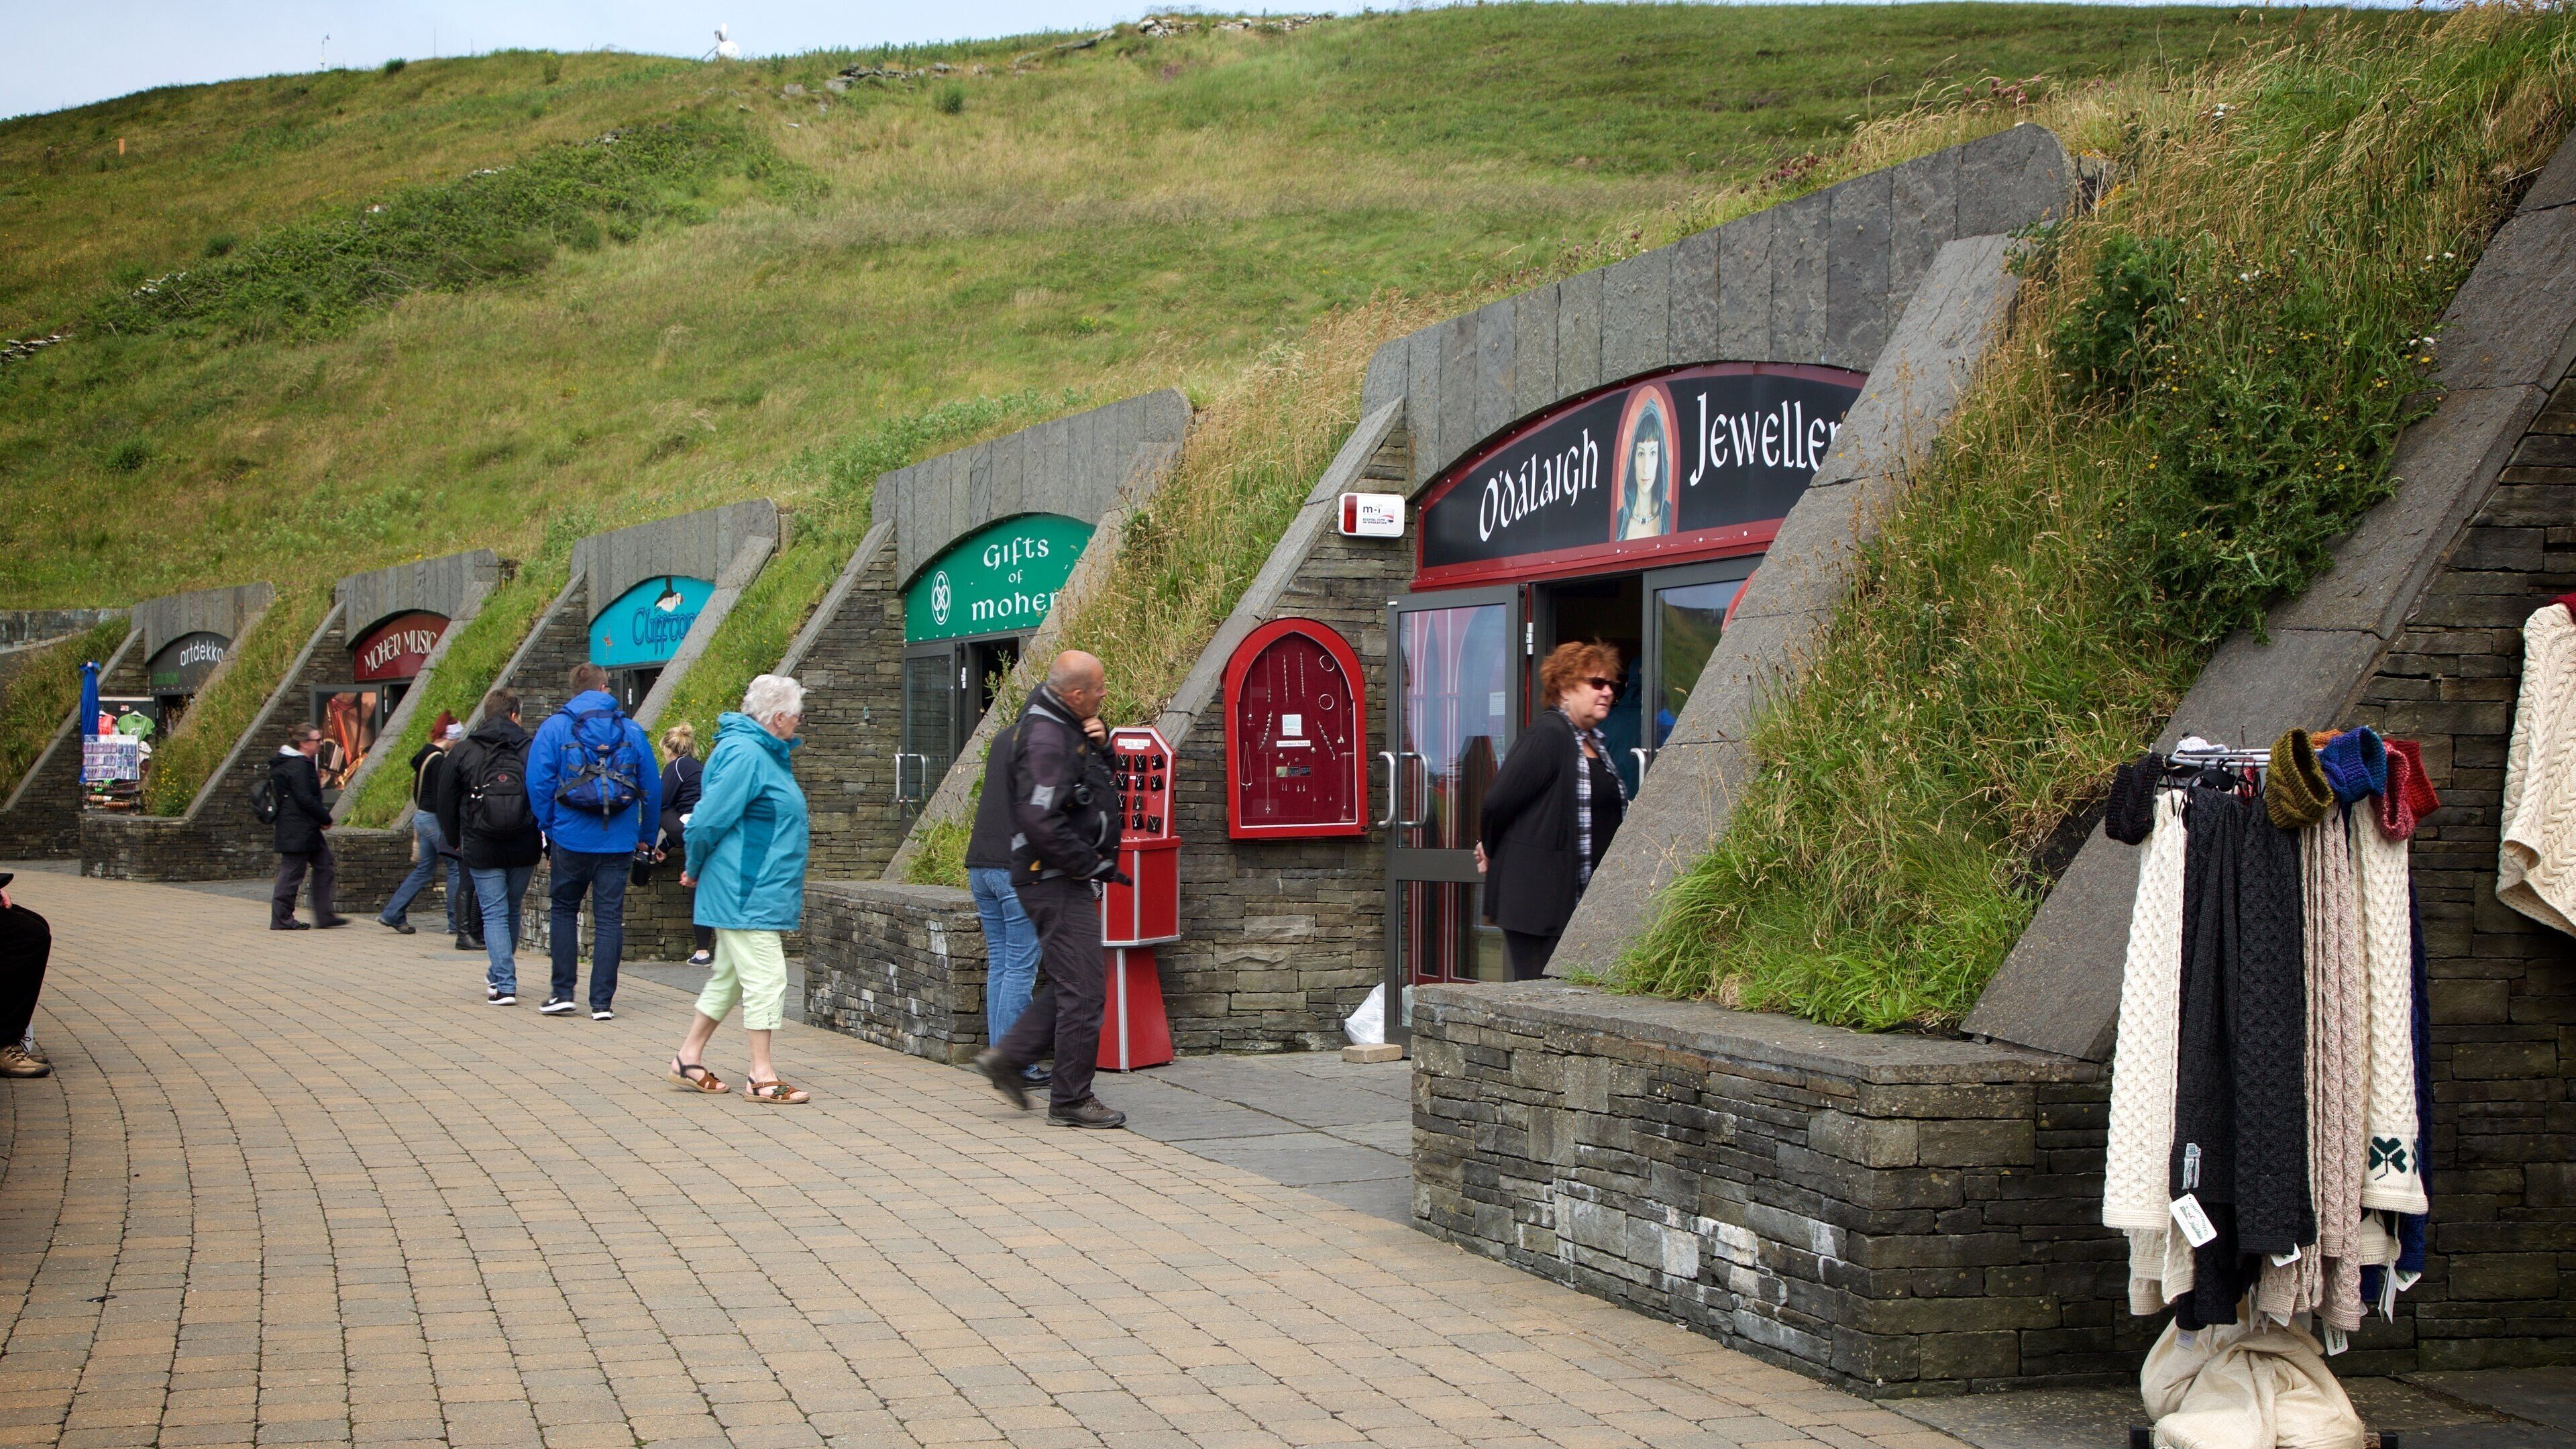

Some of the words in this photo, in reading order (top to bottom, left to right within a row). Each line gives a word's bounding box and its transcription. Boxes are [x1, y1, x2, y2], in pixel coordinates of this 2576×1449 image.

[983, 537, 1049, 570] Gifts
[1008, 569, 1023, 584] of
[180, 640, 223, 666] artdekko
[364, 633, 400, 676] MOHER
[403, 629, 437, 654] MUSIC
